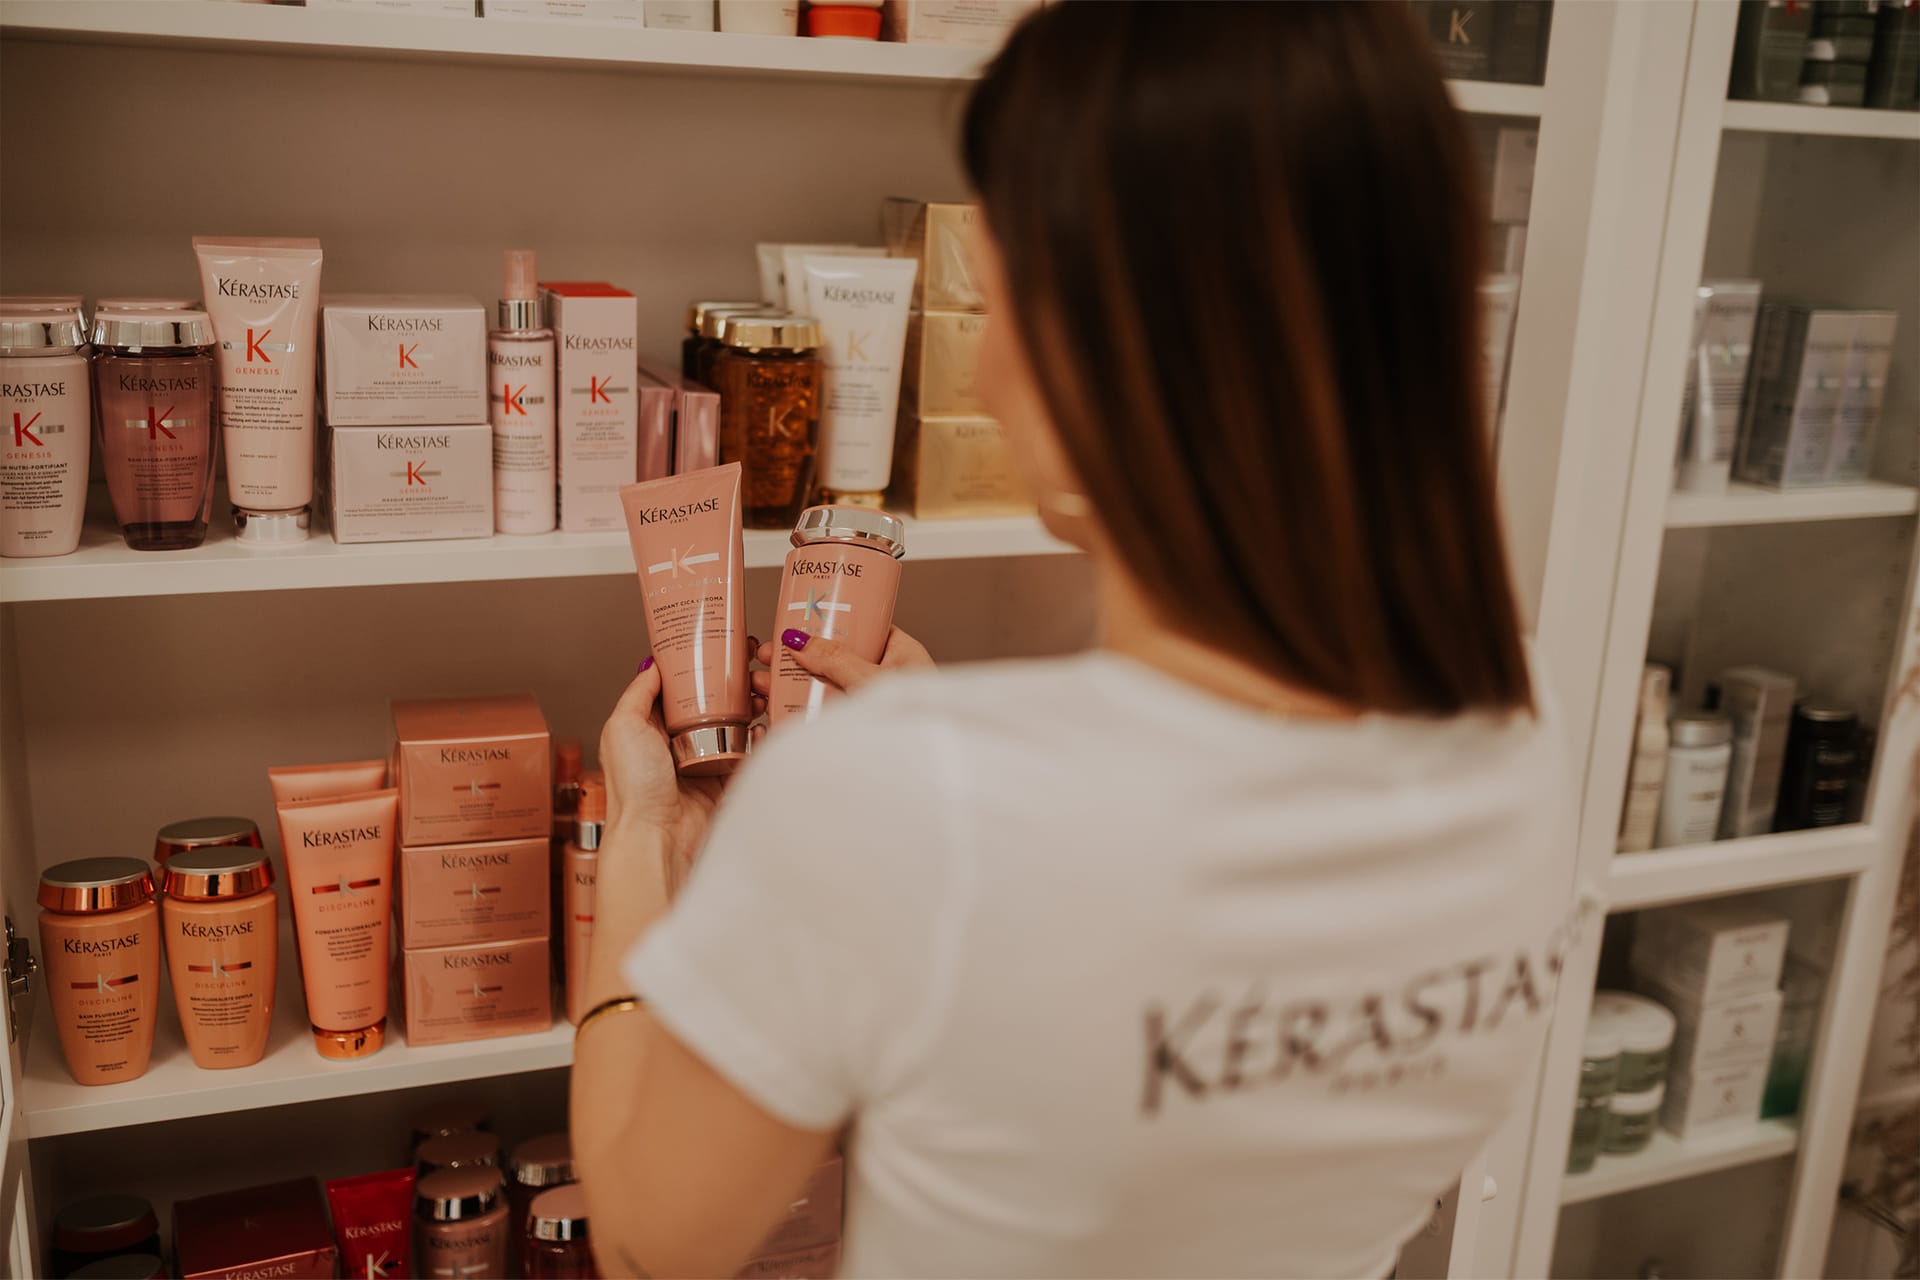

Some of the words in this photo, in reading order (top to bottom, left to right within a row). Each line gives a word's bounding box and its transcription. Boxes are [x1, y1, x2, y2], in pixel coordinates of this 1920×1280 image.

[1449, 8, 1474, 44] K
[218, 277, 300, 299] KÉRASTASE
[368, 315, 443, 331] KÉRASTASE
[246, 328, 272, 363] K
[566, 335, 634, 350] KÉRASTASE
[399, 344, 418, 368] K
[235, 367, 280, 375] GENESIS
[0, 382, 66, 397] RASTASE
[119, 375, 198, 391] KÉRASTASE
[591, 376, 612, 403] K
[504, 384, 527, 416] K
[13, 412, 43, 447] K
[148, 406, 176, 440] K
[769, 405, 796, 437] K
[377, 433, 450, 449] KÉRASTASE
[407, 460, 427, 486] K
[640, 498, 719, 525] KÉRASTASE
[791, 559, 863, 578] KÉRASTASE
[441, 748, 511, 763] KÉRASTASE
[303, 825, 381, 848] KÉRASTASE
[441, 853, 511, 869] KÉRASTASE
[319, 899, 376, 912] DISCIPLINE
[182, 921, 254, 938] KÉRASTASE
[64, 933, 140, 953] KÉRASTASE
[444, 952, 513, 969] KÉRASTASE
[79, 993, 133, 1006] DISCIPLINE
[1140, 948, 1565, 1120] KÉRASTA
